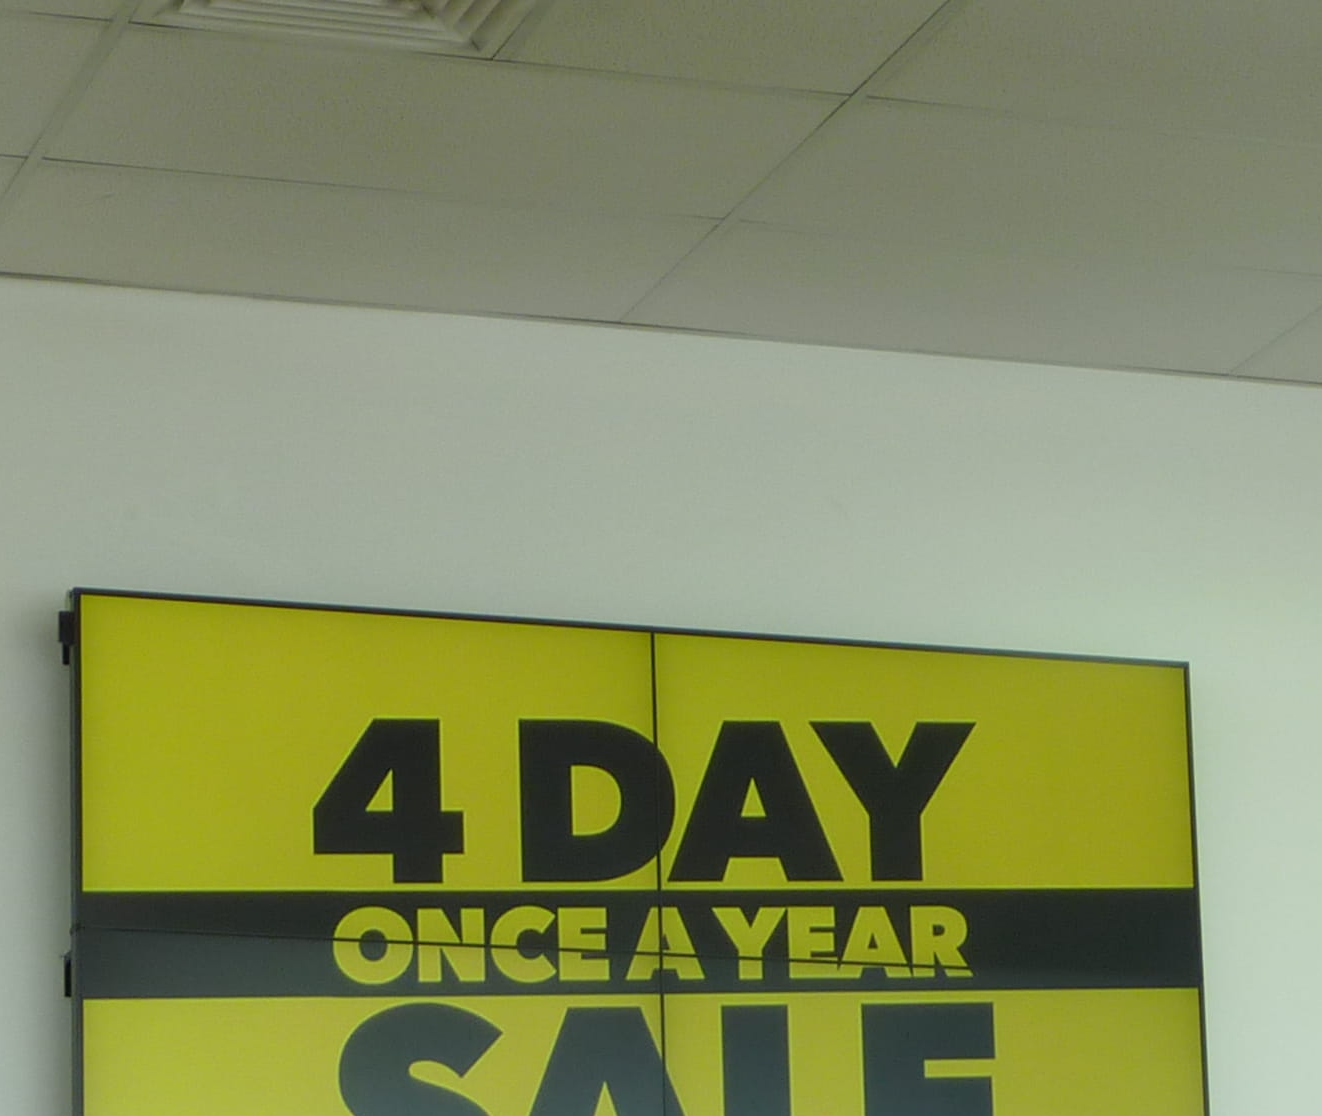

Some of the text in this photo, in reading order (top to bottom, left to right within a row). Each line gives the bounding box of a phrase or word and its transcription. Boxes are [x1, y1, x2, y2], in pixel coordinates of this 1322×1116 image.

[312, 717, 977, 884] 4 DAY
[333, 905, 975, 984] ONCE A YEAR
